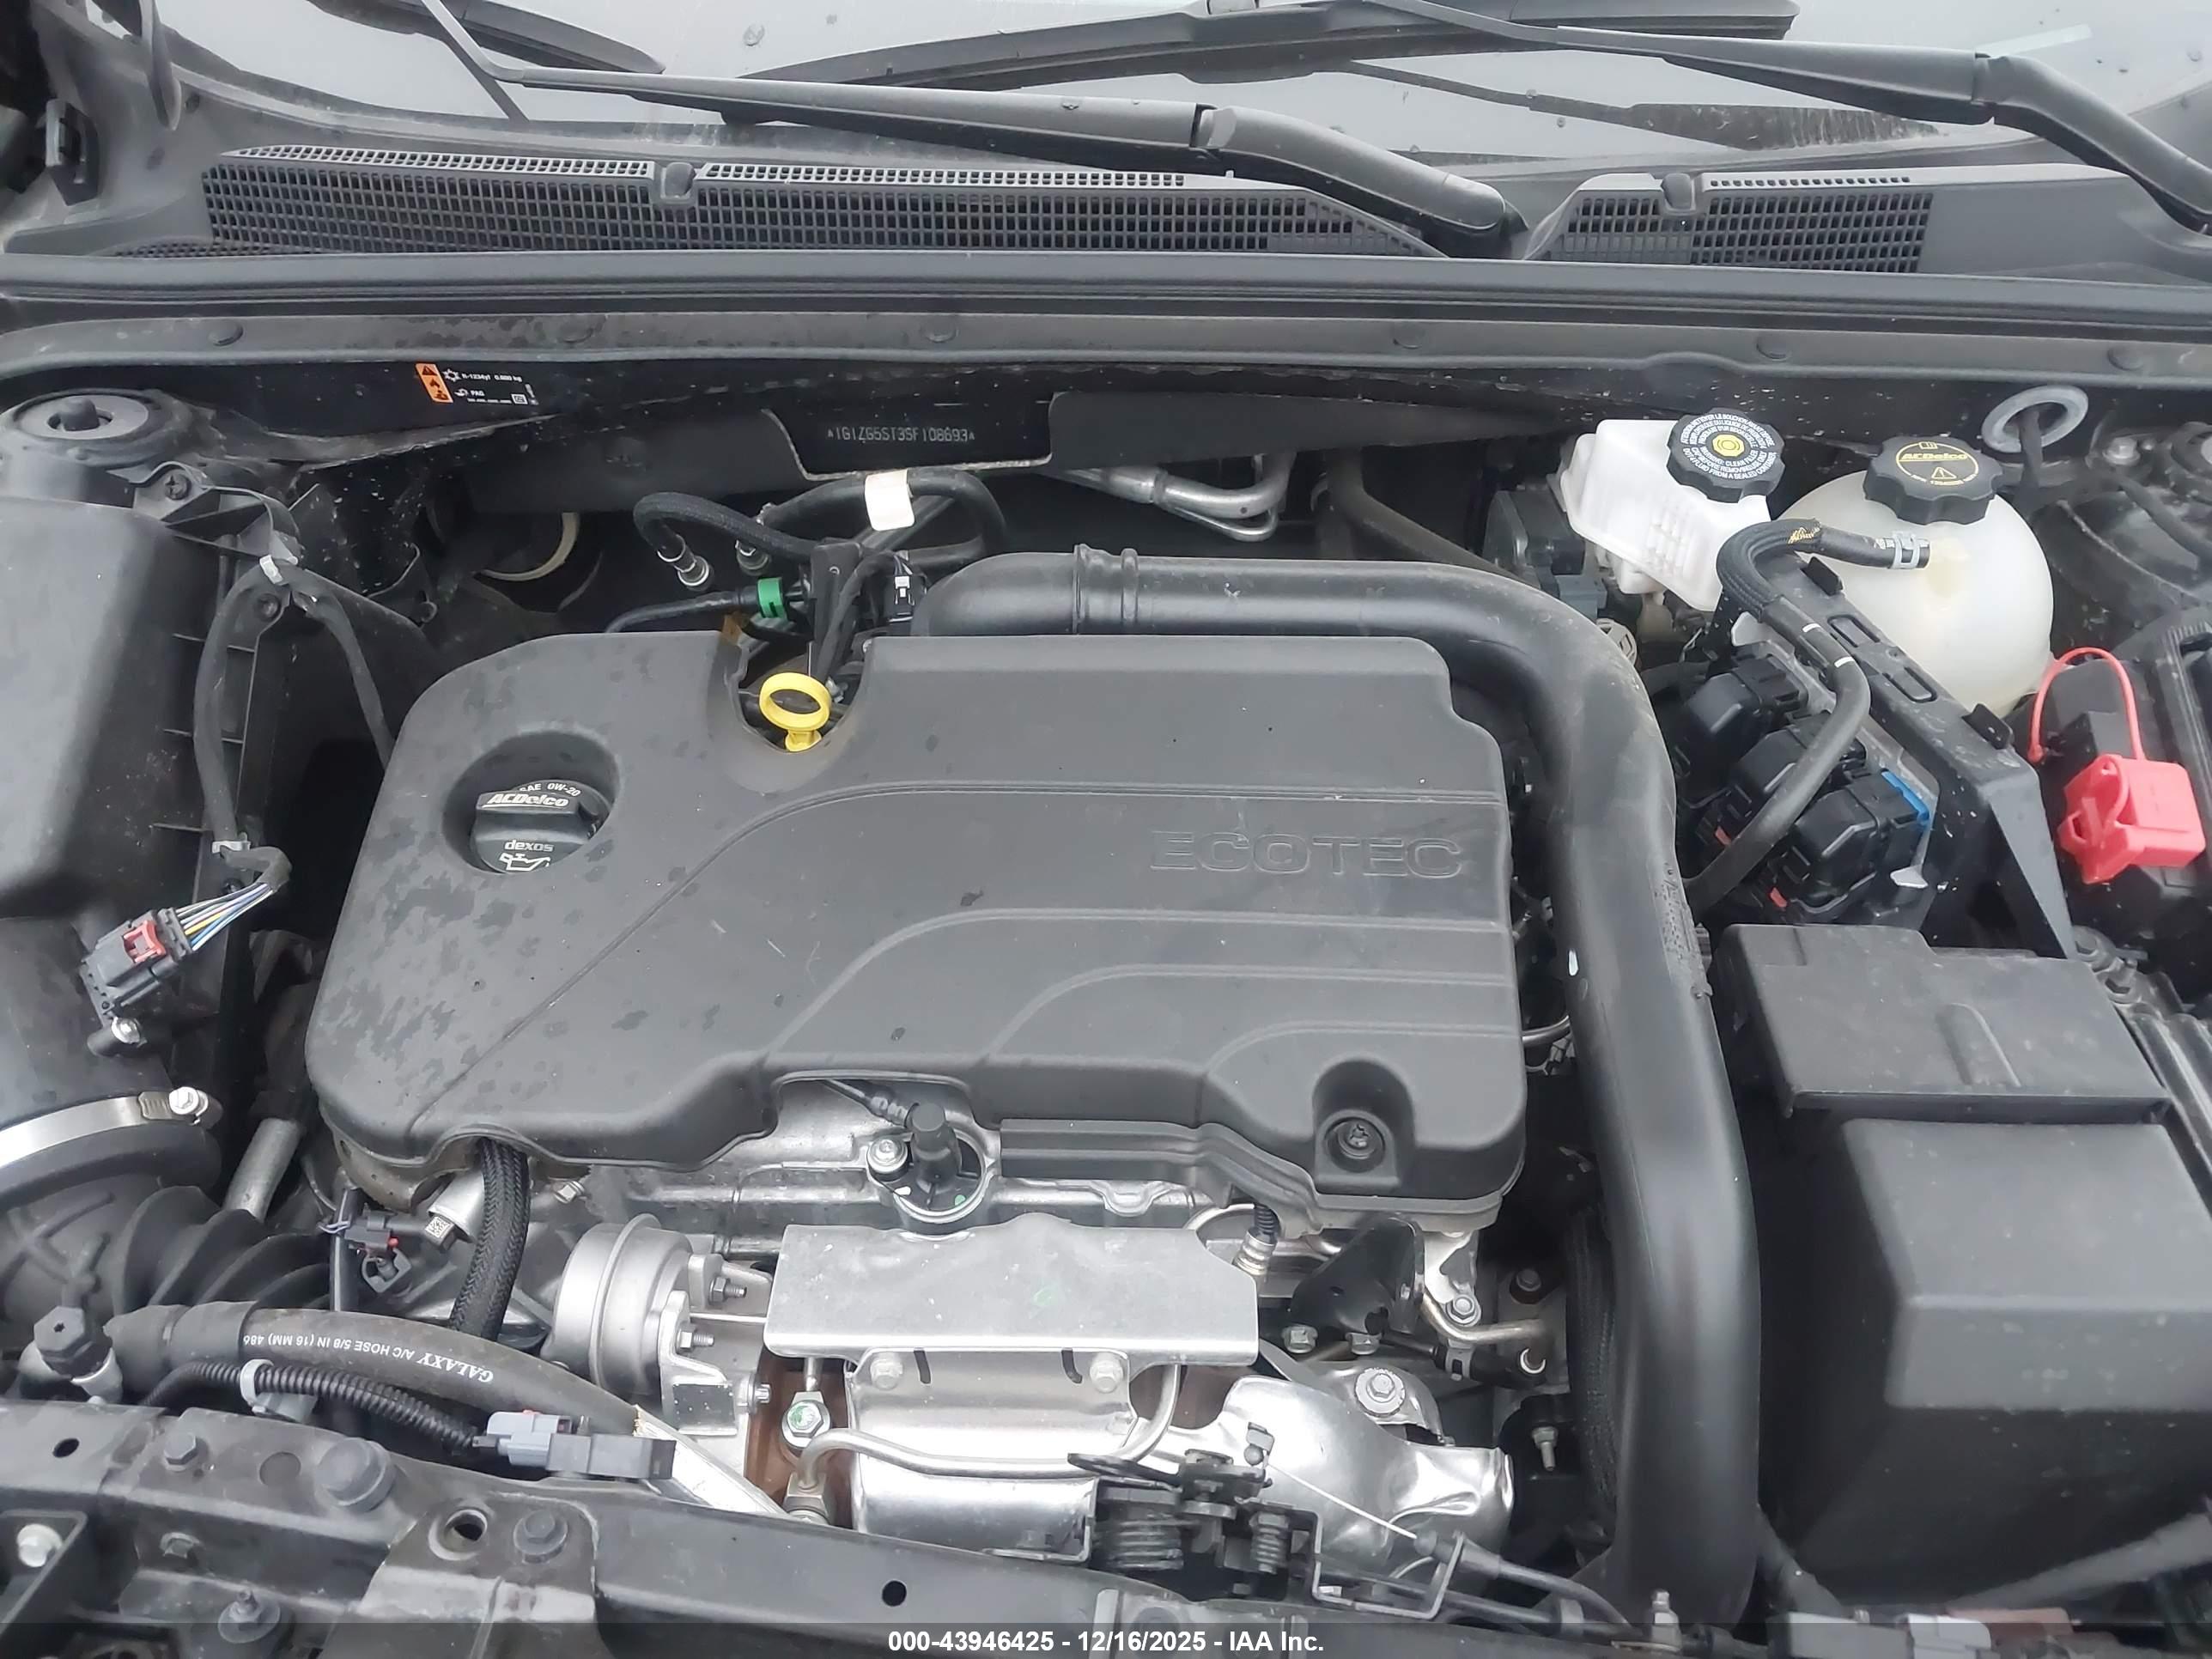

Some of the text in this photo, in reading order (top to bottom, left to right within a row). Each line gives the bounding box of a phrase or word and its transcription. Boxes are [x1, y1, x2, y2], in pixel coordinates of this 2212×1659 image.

[1900, 452, 1968, 461] ACDelco
[1692, 459, 1710, 471] FLUID
[1709, 468, 1728, 478] FROM
[1734, 471, 1758, 479] SEALED
[547, 782, 581, 797] 0W-20
[487, 793, 569, 807] ACDelco
[504, 839, 555, 852] dexos
[1150, 830, 1462, 878] ECOTEC
[267, 1333, 294, 1346] MM)
[295, 1333, 314, 1346] (16
[317, 1336, 331, 1348] IN
[333, 1338, 352, 1350] 5/8
[354, 1340, 391, 1356] HOSE
[392, 1346, 416, 1361] A/C
[416, 1352, 494, 1382] GALAXY
